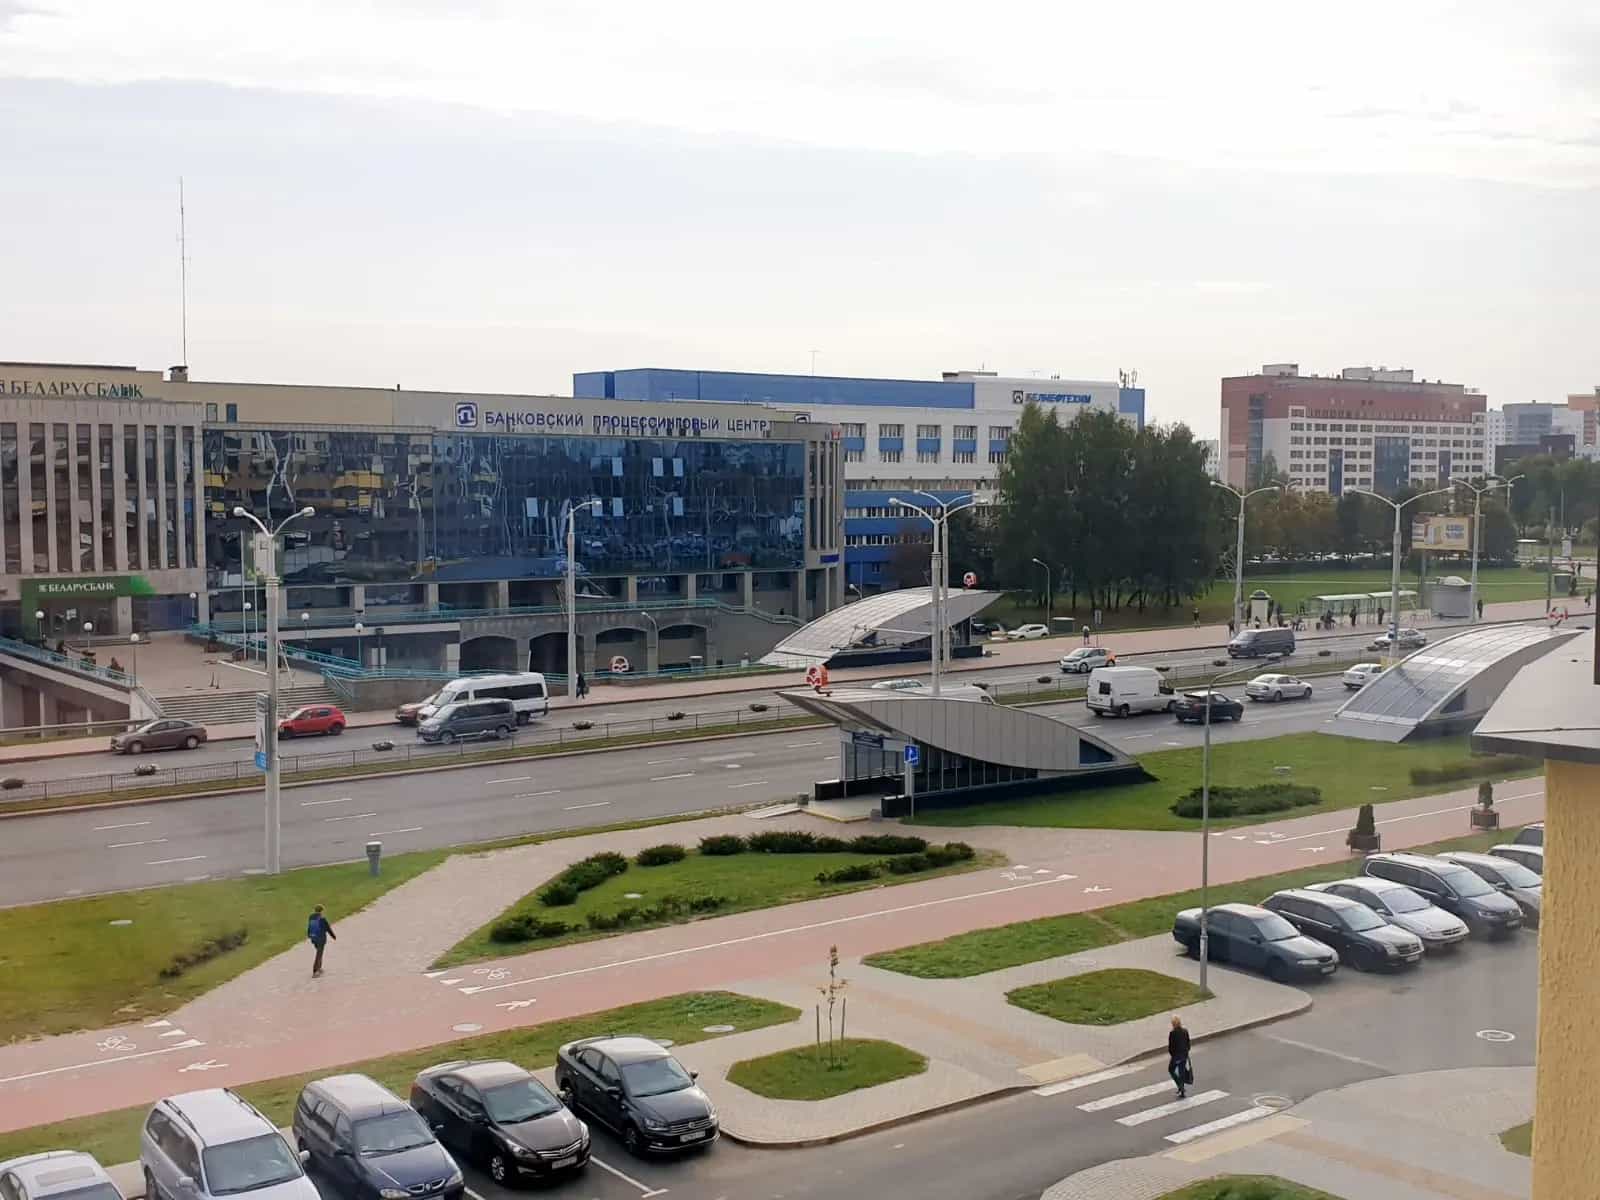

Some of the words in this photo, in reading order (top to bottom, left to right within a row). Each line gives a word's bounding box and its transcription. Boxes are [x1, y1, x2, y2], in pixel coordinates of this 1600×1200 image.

[11, 380, 143, 399] БЕЛАРУСБАНК
[485, 411, 584, 427] БАНКОВСКИЙ
[592, 415, 719, 431] ПРОЦЕССИНГОВЫЙ
[727, 419, 767, 431] ЦЕНТР
[48, 582, 115, 593] БЕЛАРУСБАНК
